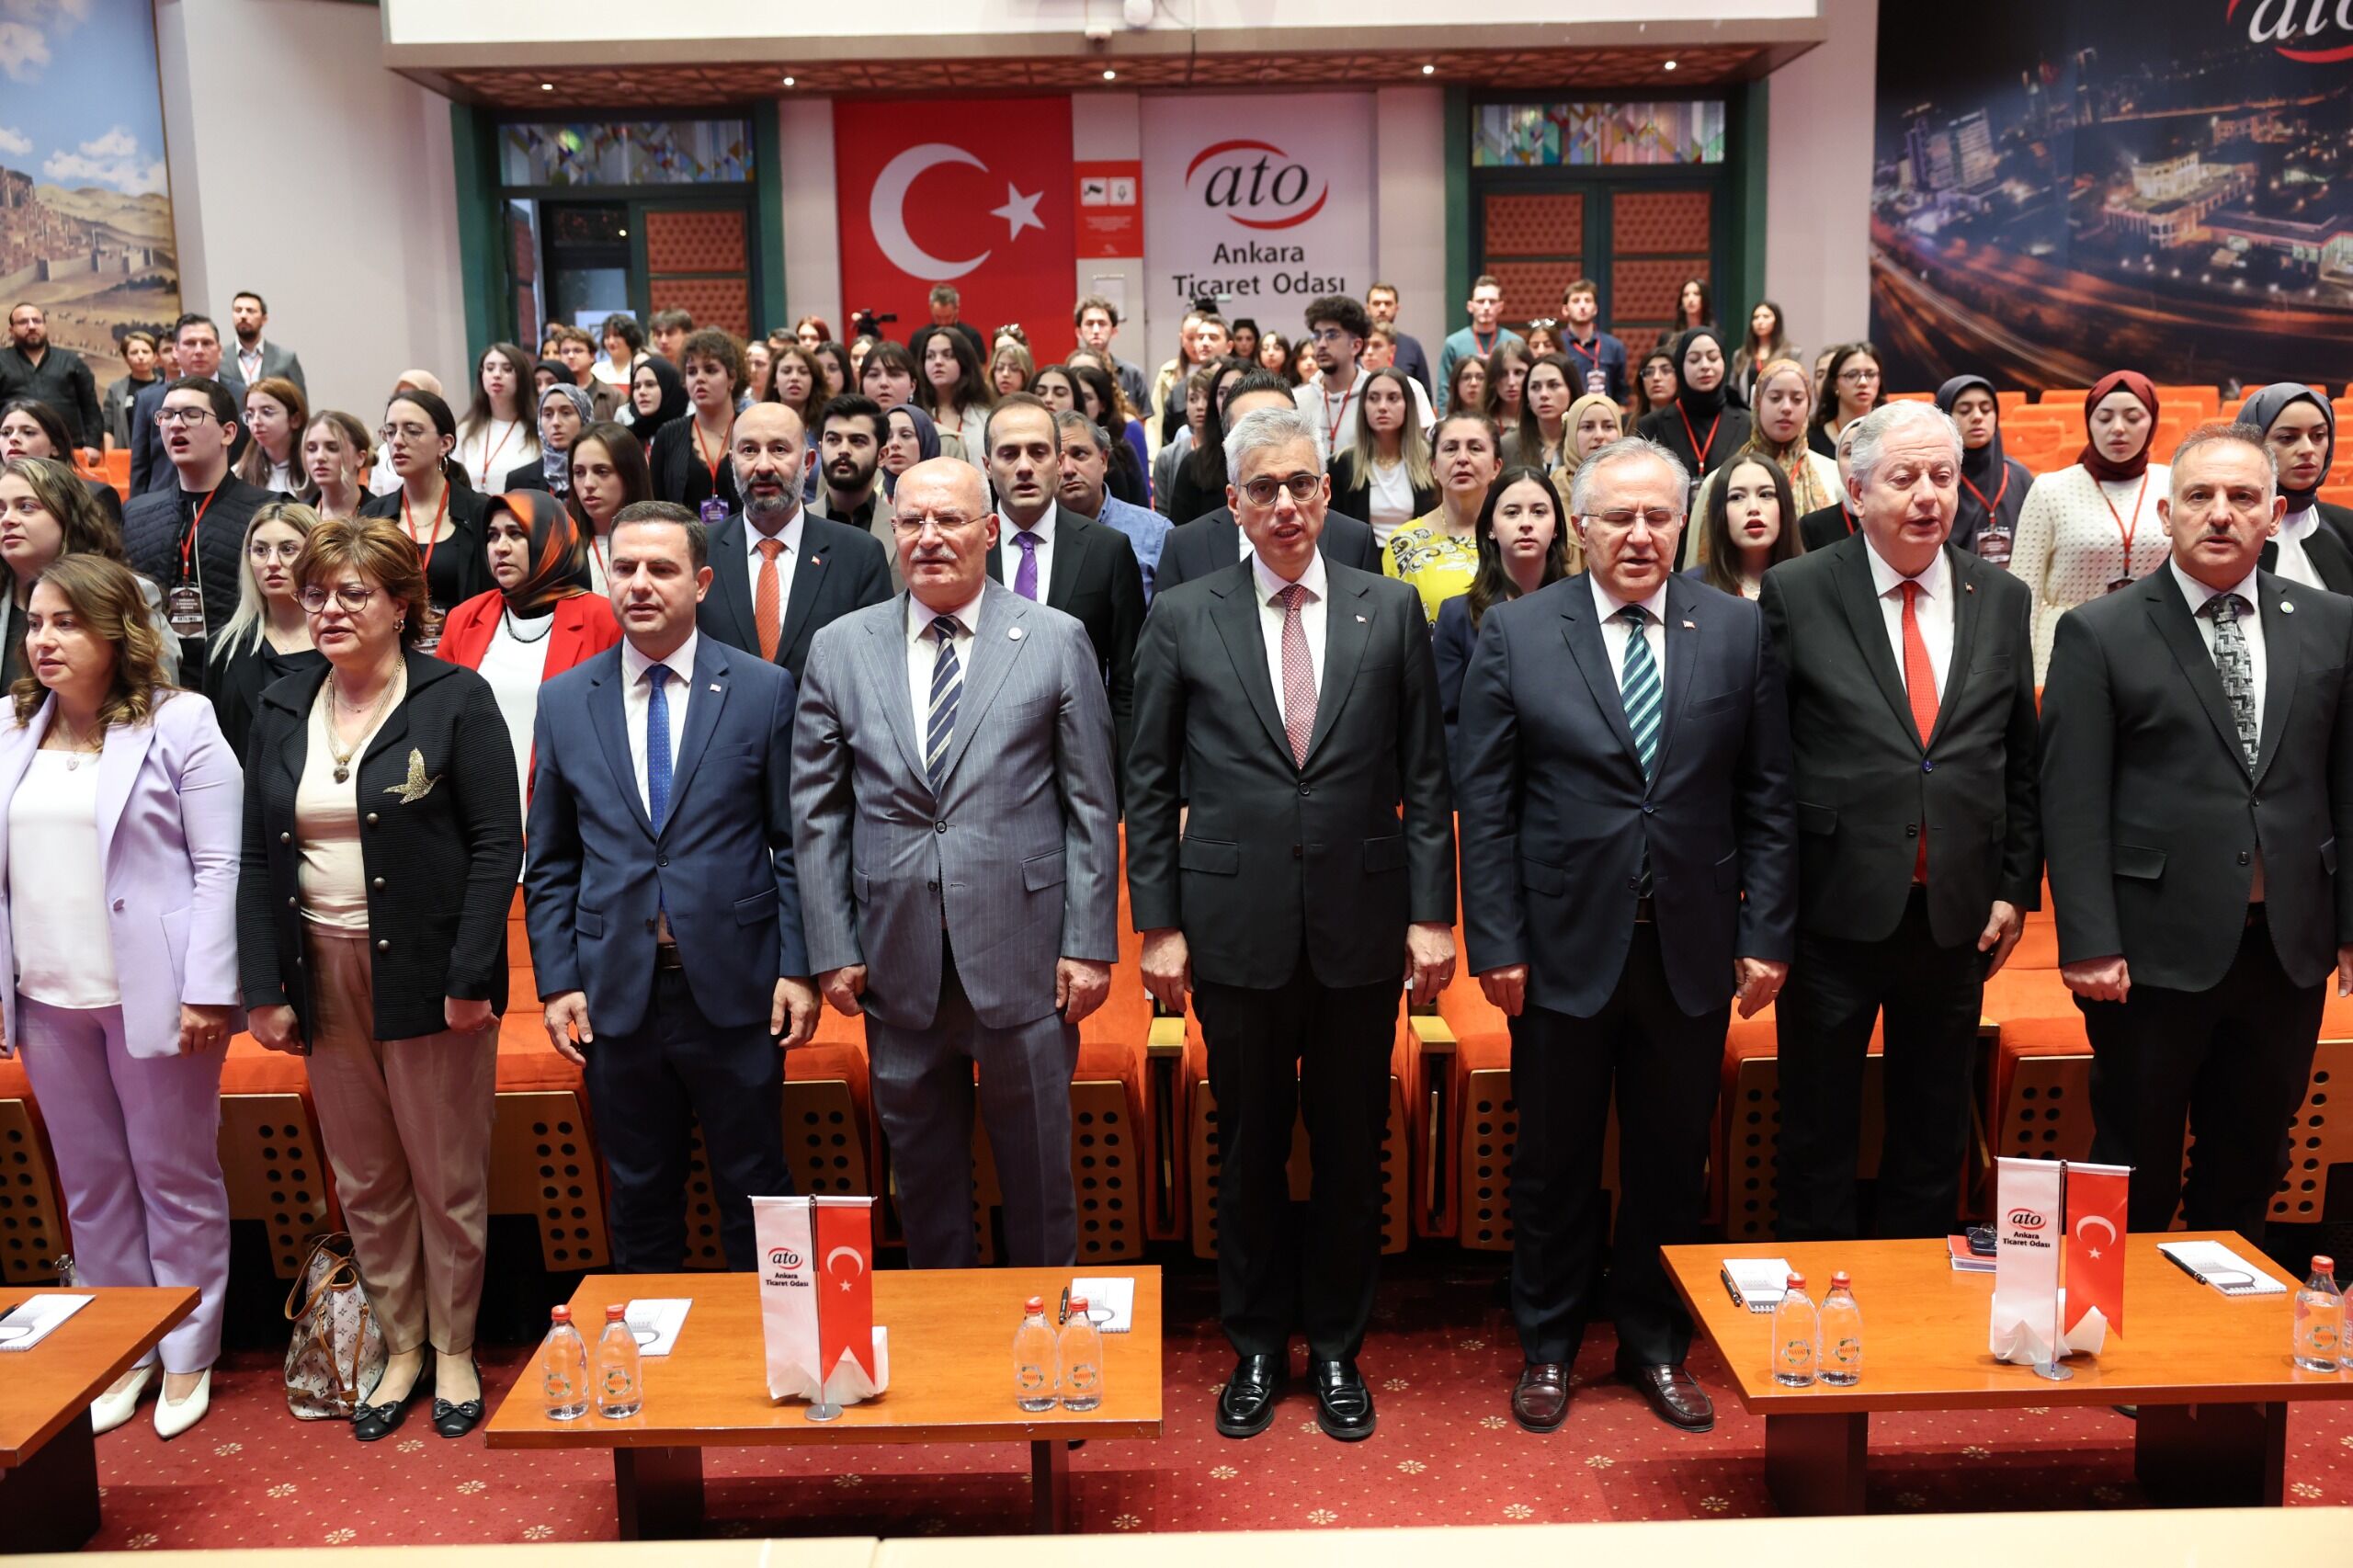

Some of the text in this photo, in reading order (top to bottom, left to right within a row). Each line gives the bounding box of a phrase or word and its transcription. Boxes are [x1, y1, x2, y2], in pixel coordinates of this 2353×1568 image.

[1204, 154, 1310, 208] ato
[1212, 241, 1305, 265] Ankara
[1171, 270, 1346, 297] Ticaret Odası
[2012, 1212, 2041, 1226] ato
[2013, 1231, 2040, 1240] Ankara
[2002, 1238, 2051, 1248] Ticaret Odası
[772, 1250, 799, 1265] ato
[765, 1278, 789, 1287] Ticaret
